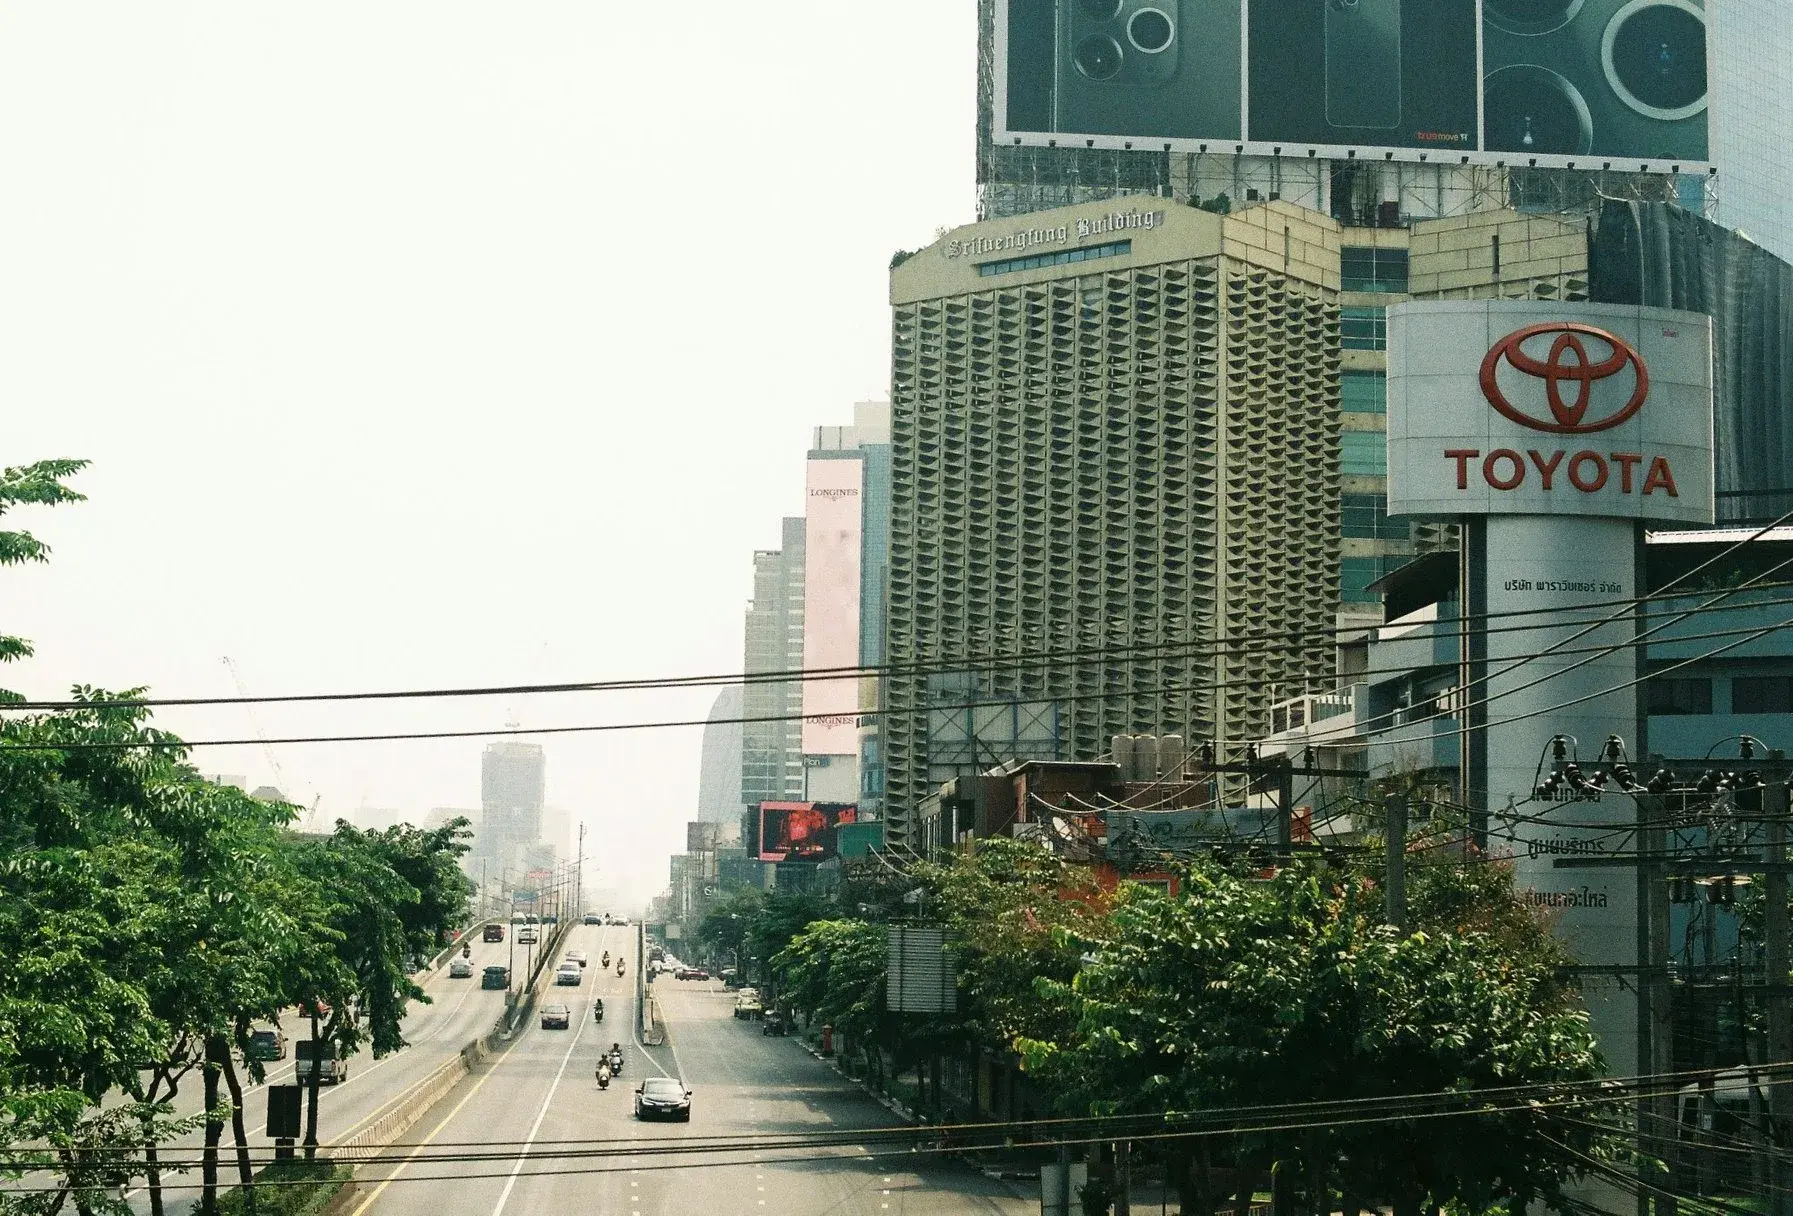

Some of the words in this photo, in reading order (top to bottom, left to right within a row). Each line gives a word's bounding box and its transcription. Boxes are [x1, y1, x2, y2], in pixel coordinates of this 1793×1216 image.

[1075, 208, 1156, 242] Building
[1444, 448, 1679, 498] TOYOTA
[810, 488, 858, 497] LONGINES
[1504, 579, 1532, 591] บริษัท
[805, 715, 854, 724] LONGINES
